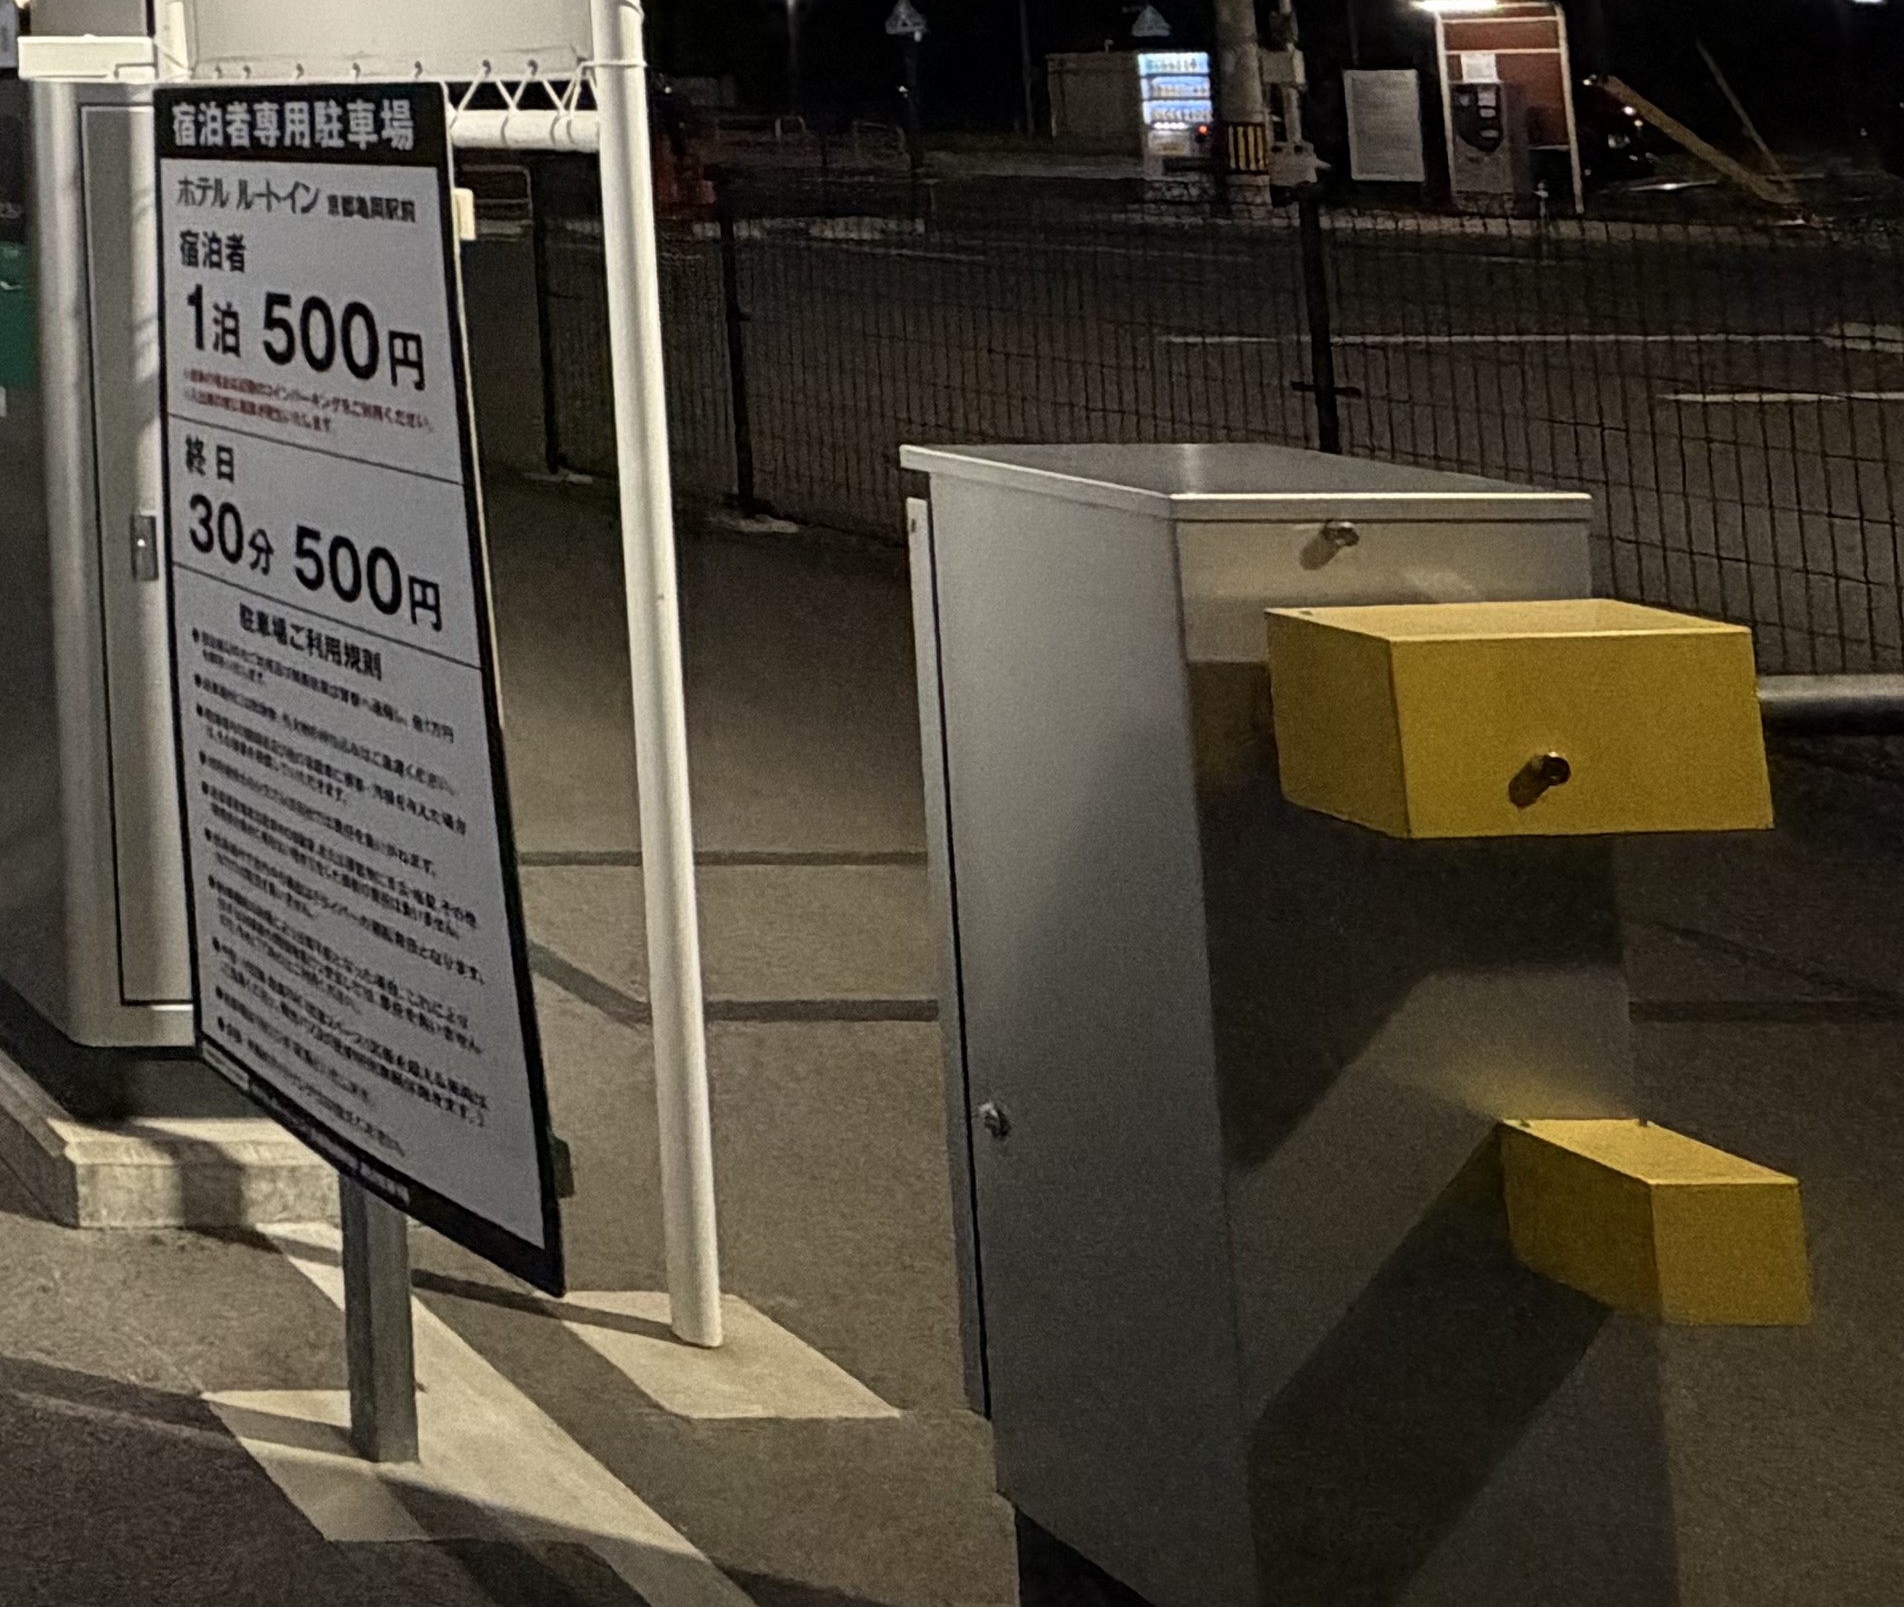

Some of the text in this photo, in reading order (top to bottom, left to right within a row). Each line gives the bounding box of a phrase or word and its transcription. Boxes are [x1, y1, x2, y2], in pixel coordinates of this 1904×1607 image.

[172, 98, 414, 151] 宿泊者専用駐車場
[177, 175, 230, 208] ホテル
[236, 178, 321, 214] ルートイン
[179, 229, 247, 273] 宿泊者
[186, 283, 426, 392] 1泊 500円
[189, 493, 443, 632] 30分 500円
